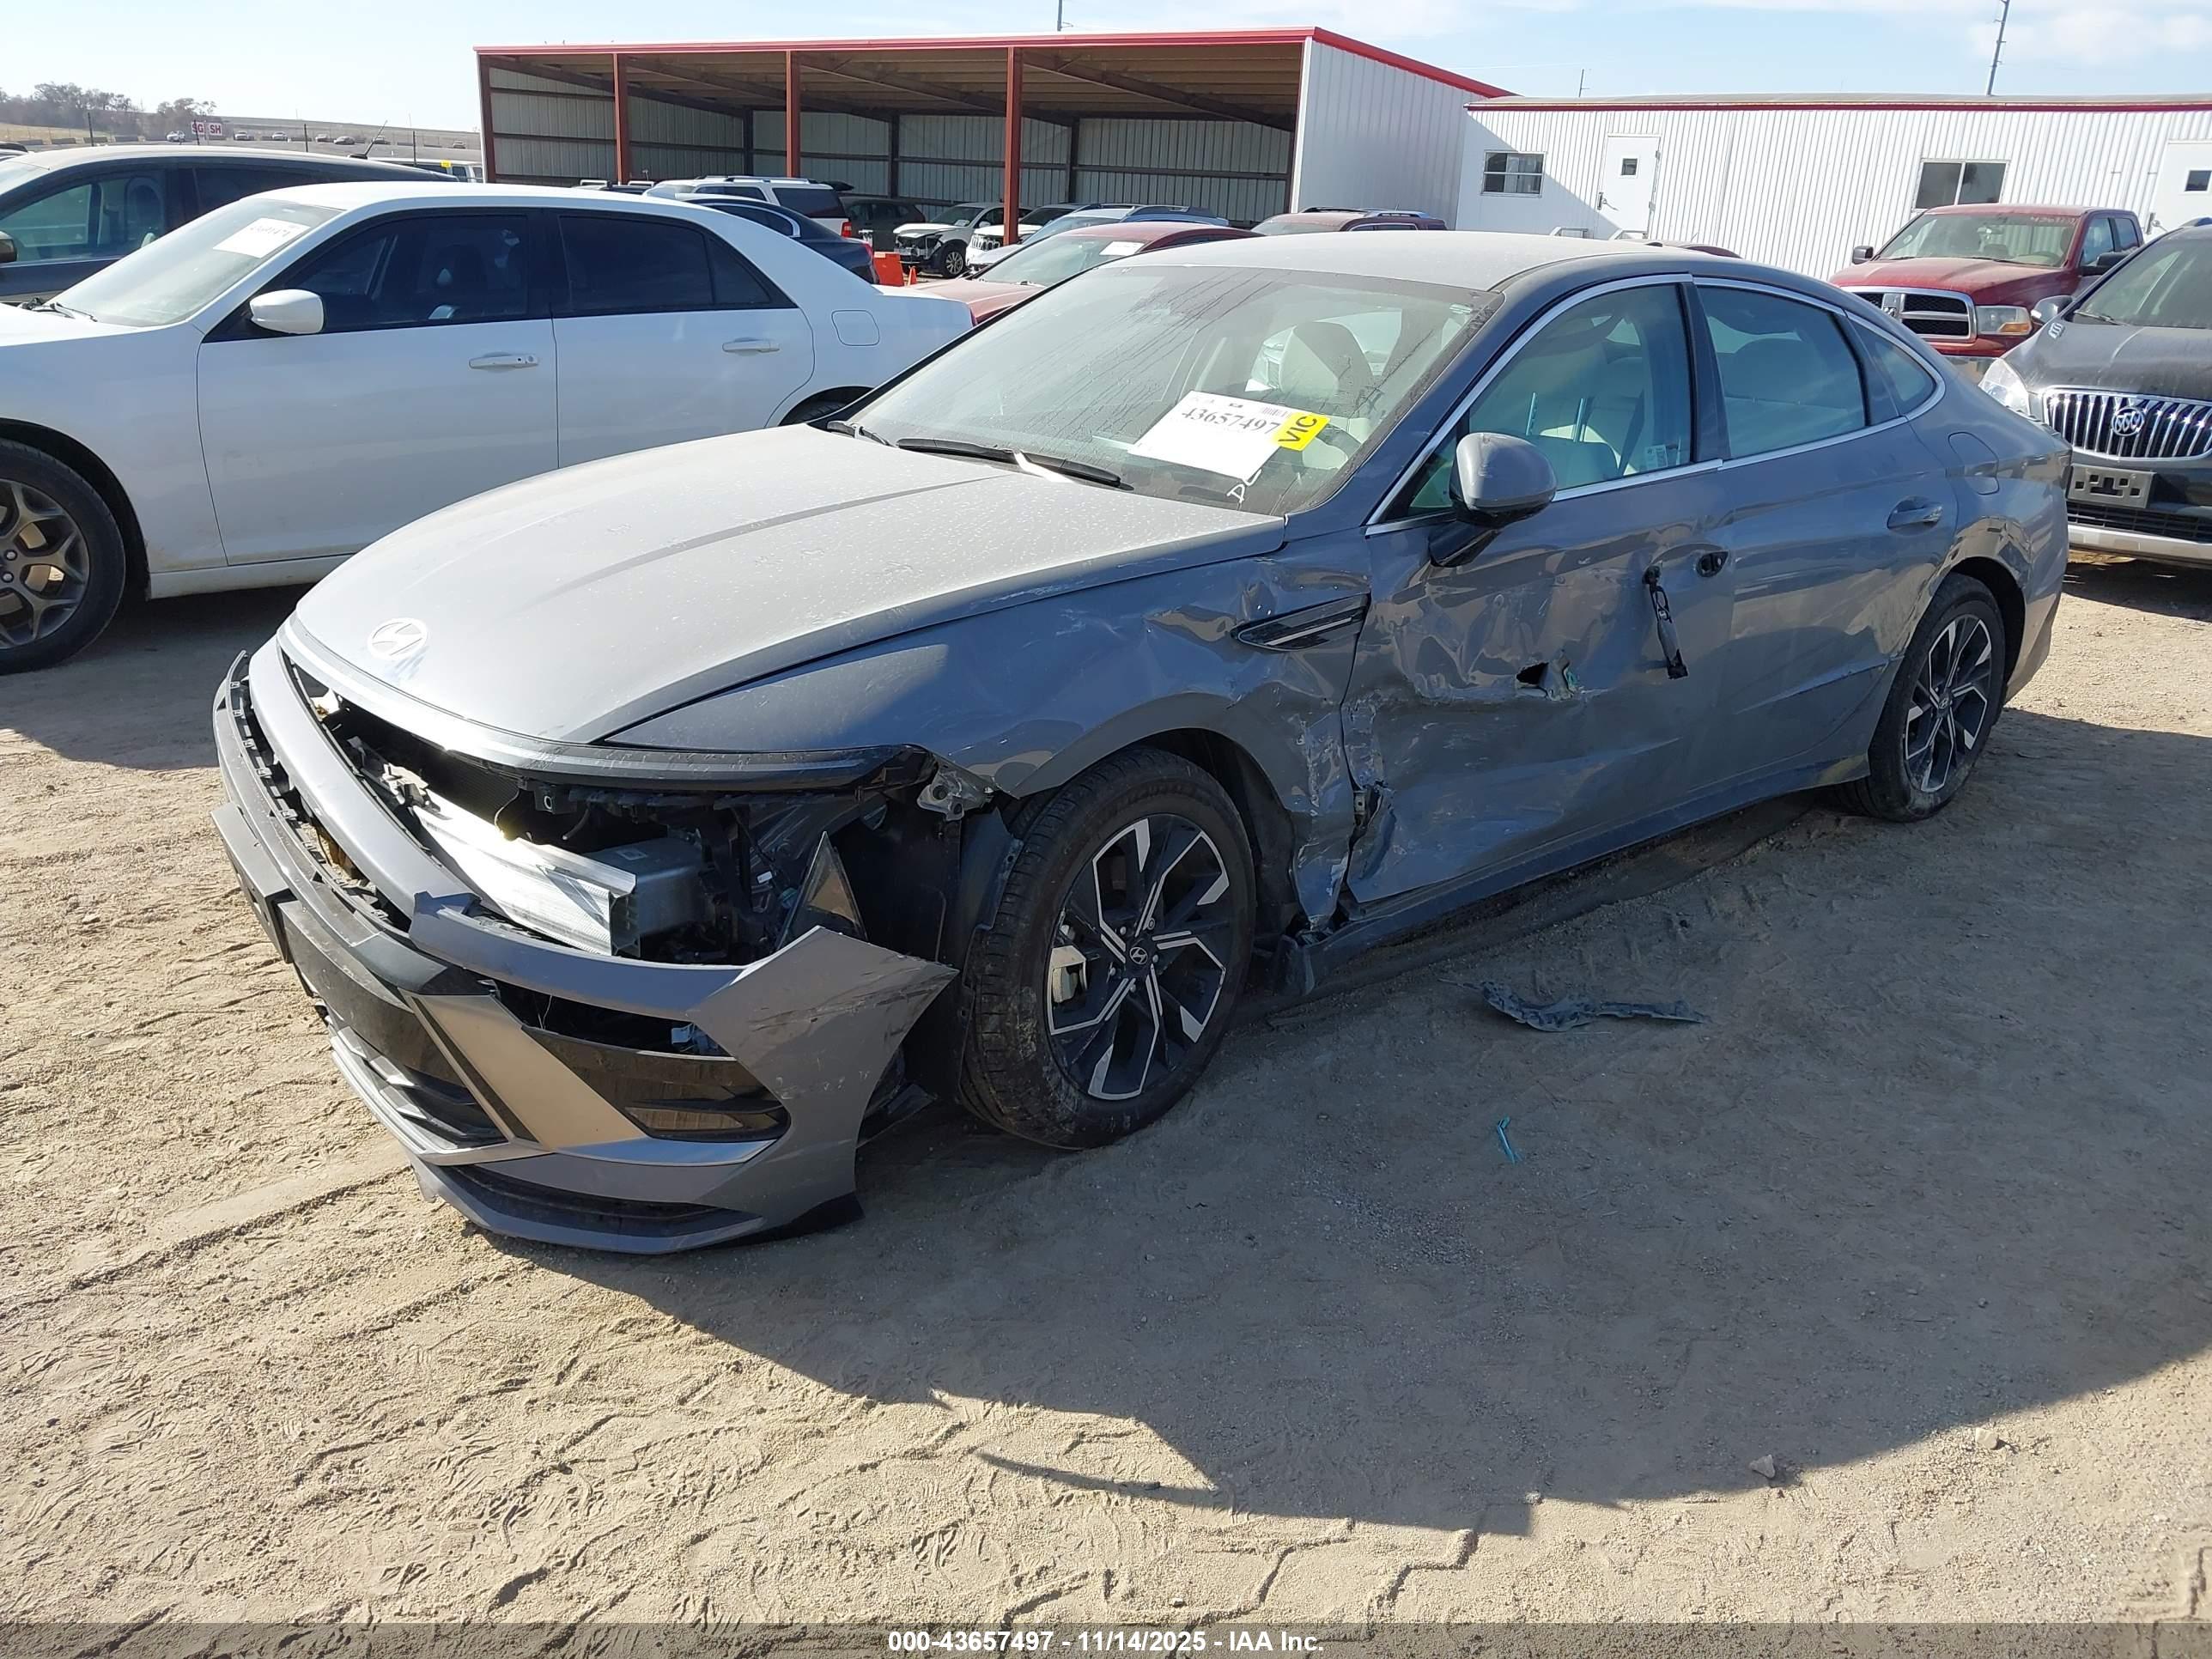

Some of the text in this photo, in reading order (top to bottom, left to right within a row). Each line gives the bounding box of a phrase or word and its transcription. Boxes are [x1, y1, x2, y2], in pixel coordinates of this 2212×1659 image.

[210, 125, 222, 134] SH
[1182, 407, 1281, 434] 43657497
[1277, 416, 1318, 442] VIC
